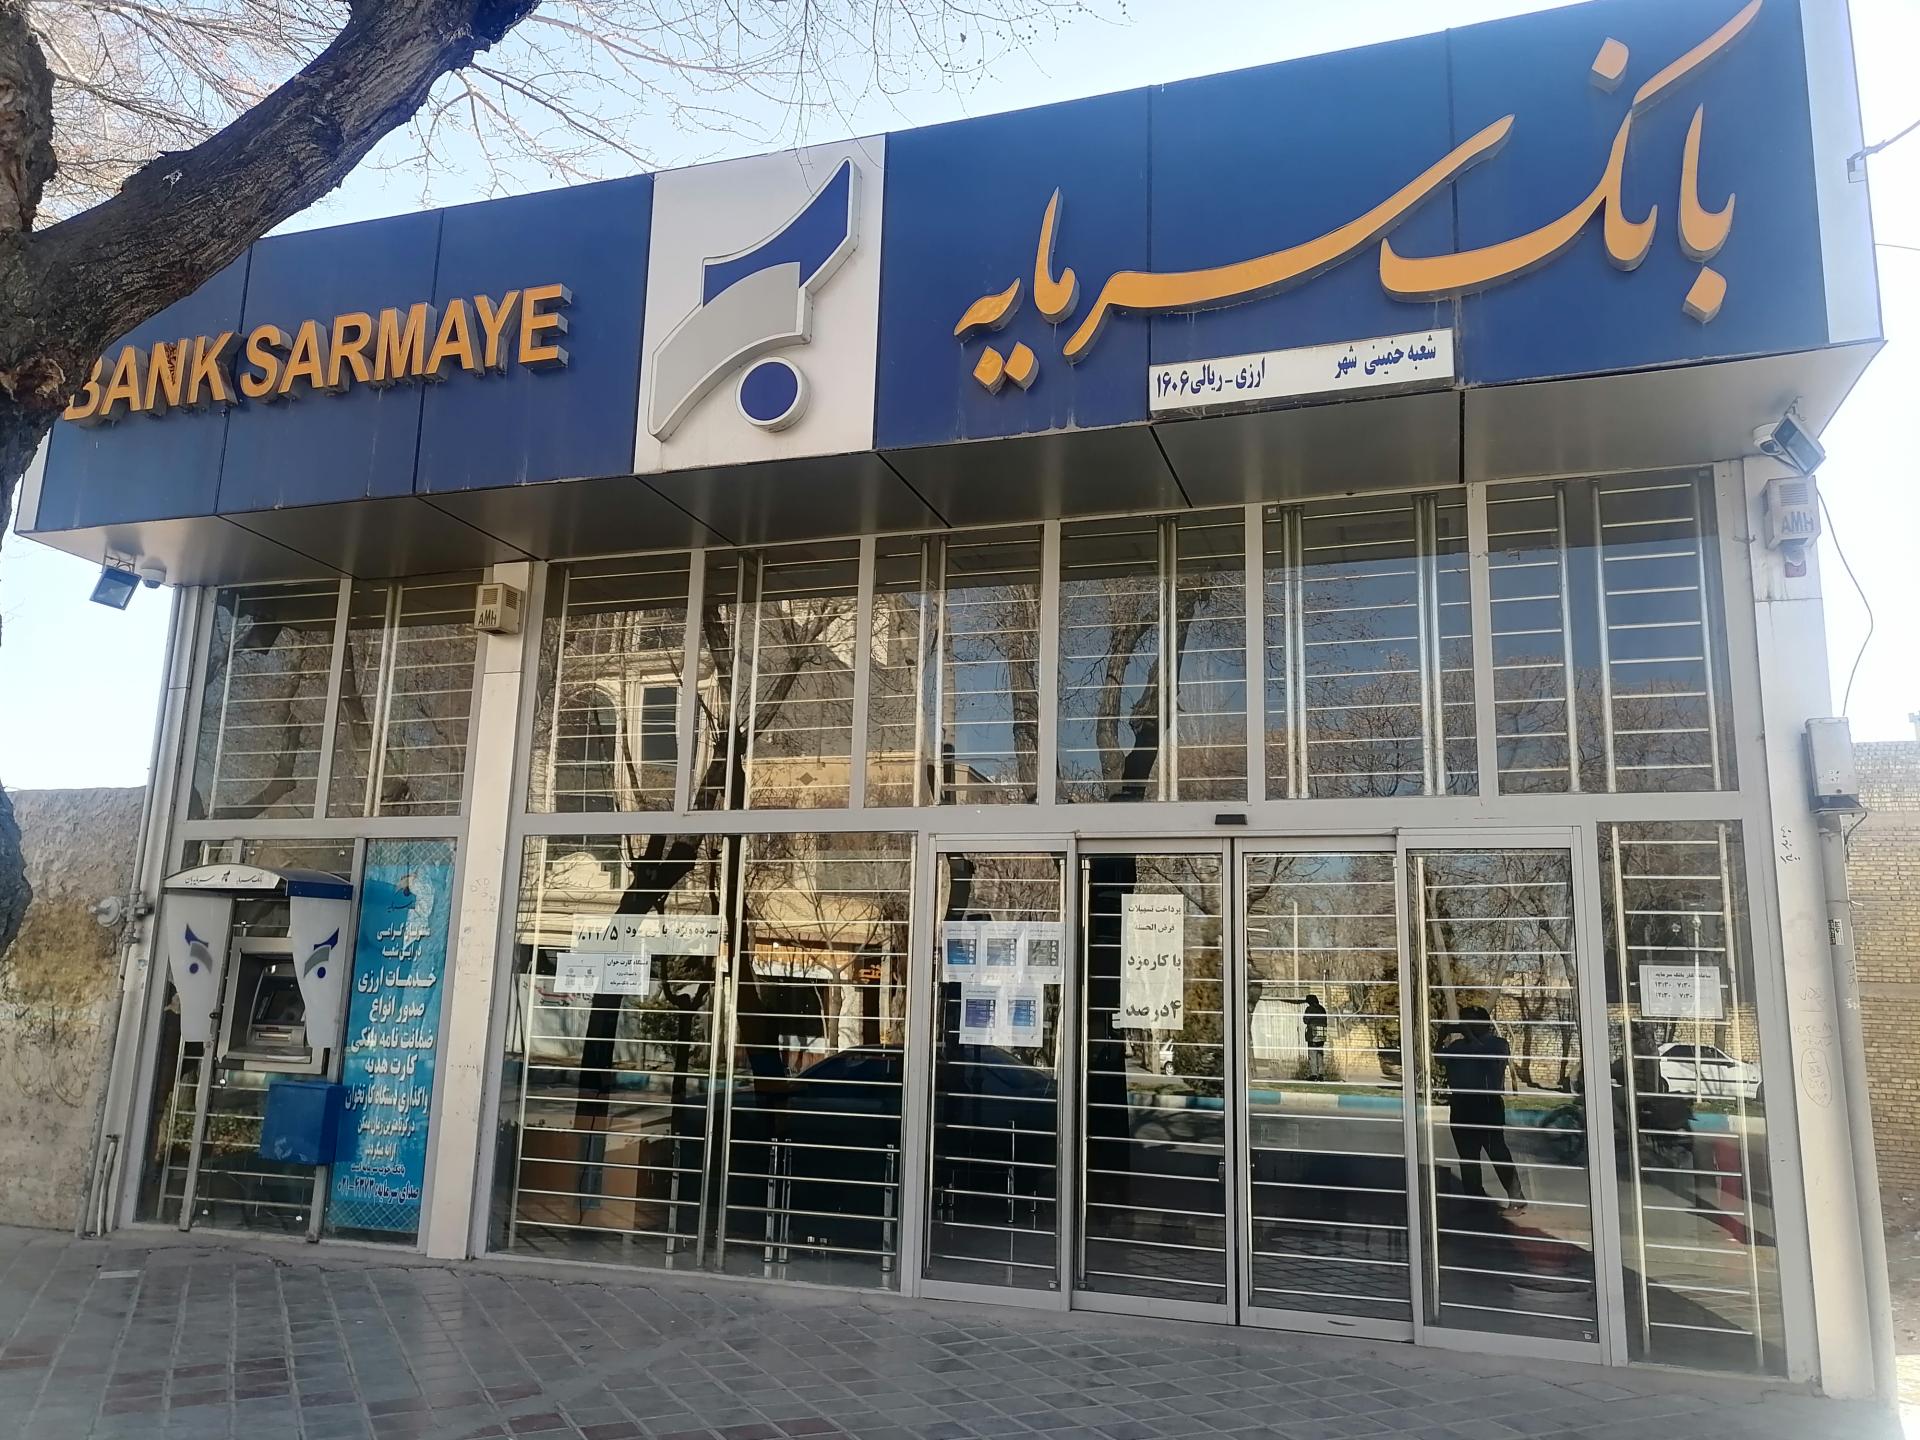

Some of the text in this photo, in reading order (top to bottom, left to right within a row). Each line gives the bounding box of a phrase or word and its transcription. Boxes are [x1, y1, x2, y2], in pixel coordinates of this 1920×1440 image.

[954, 0, 1763, 395] بانک سرمایه
[239, 282, 570, 400] SARMAYE
[1334, 334, 1437, 380] شعبه خمینی شهر
[1781, 511, 1814, 534] AMH
[477, 608, 497, 626] AMH
[1128, 904, 1182, 916] پرداخت تسهیلات
[377, 922, 405, 941] گرامی
[661, 923, 668, 938] با
[694, 926, 719, 938] سپرده
[1157, 924, 1175, 934] قرض
[382, 942, 422, 961] در این شعبه
[1127, 953, 1182, 971] با کارمزد
[357, 966, 437, 993] خدمات ارزی
[369, 994, 425, 1023] صدور انواع
[351, 1026, 434, 1053] ضمانت نامه بانکی
[365, 1053, 418, 1082] کارت هدیه
[375, 1083, 398, 1106] دستگاه
[398, 1084, 429, 1115] واگذاری
[398, 1180, 420, 1205] صدای
